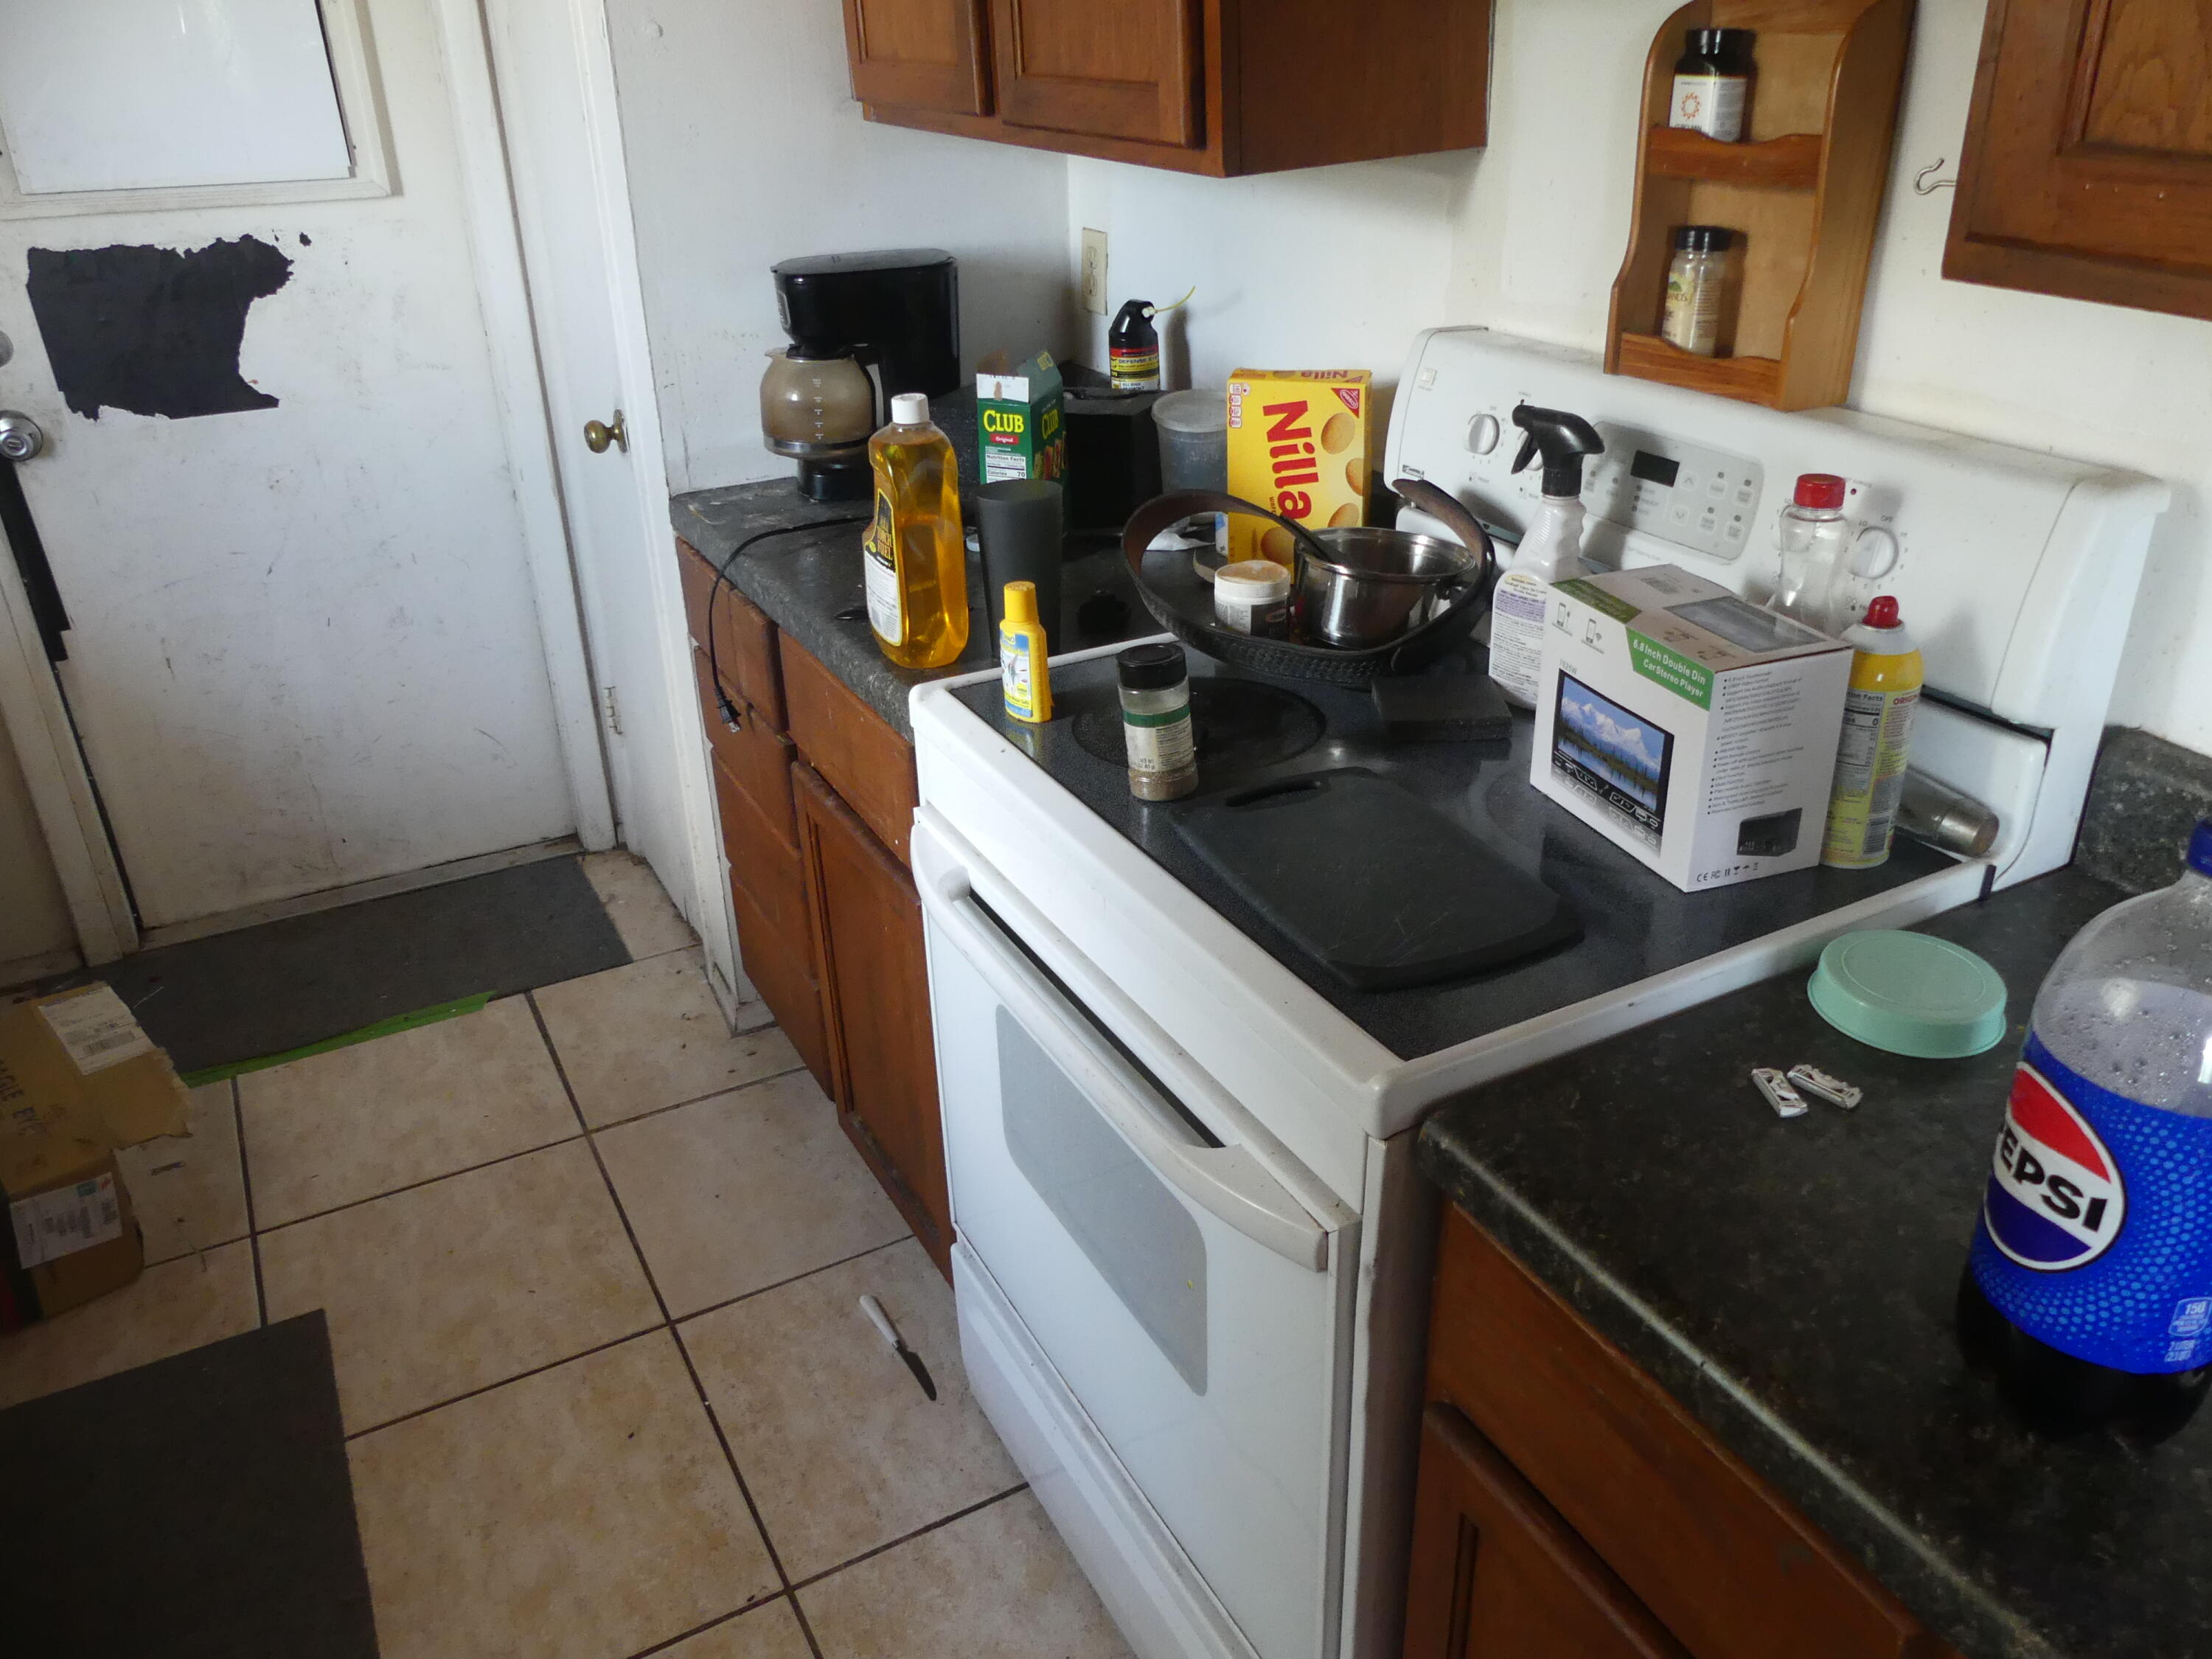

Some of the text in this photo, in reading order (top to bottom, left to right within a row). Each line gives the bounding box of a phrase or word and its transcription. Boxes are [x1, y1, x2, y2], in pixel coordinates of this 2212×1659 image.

[1301, 370, 1349, 379] Nilla
[983, 409, 1025, 434] CLUB
[1042, 409, 1059, 439] CLUB
[1263, 400, 1319, 520] Nilla
[1633, 639, 1705, 685] 6.8 Inch Double Din
[1643, 659, 1704, 697] Car Stereo Player
[1999, 1127, 2108, 1233] EPSI
[2185, 1301, 2208, 1315] 150
